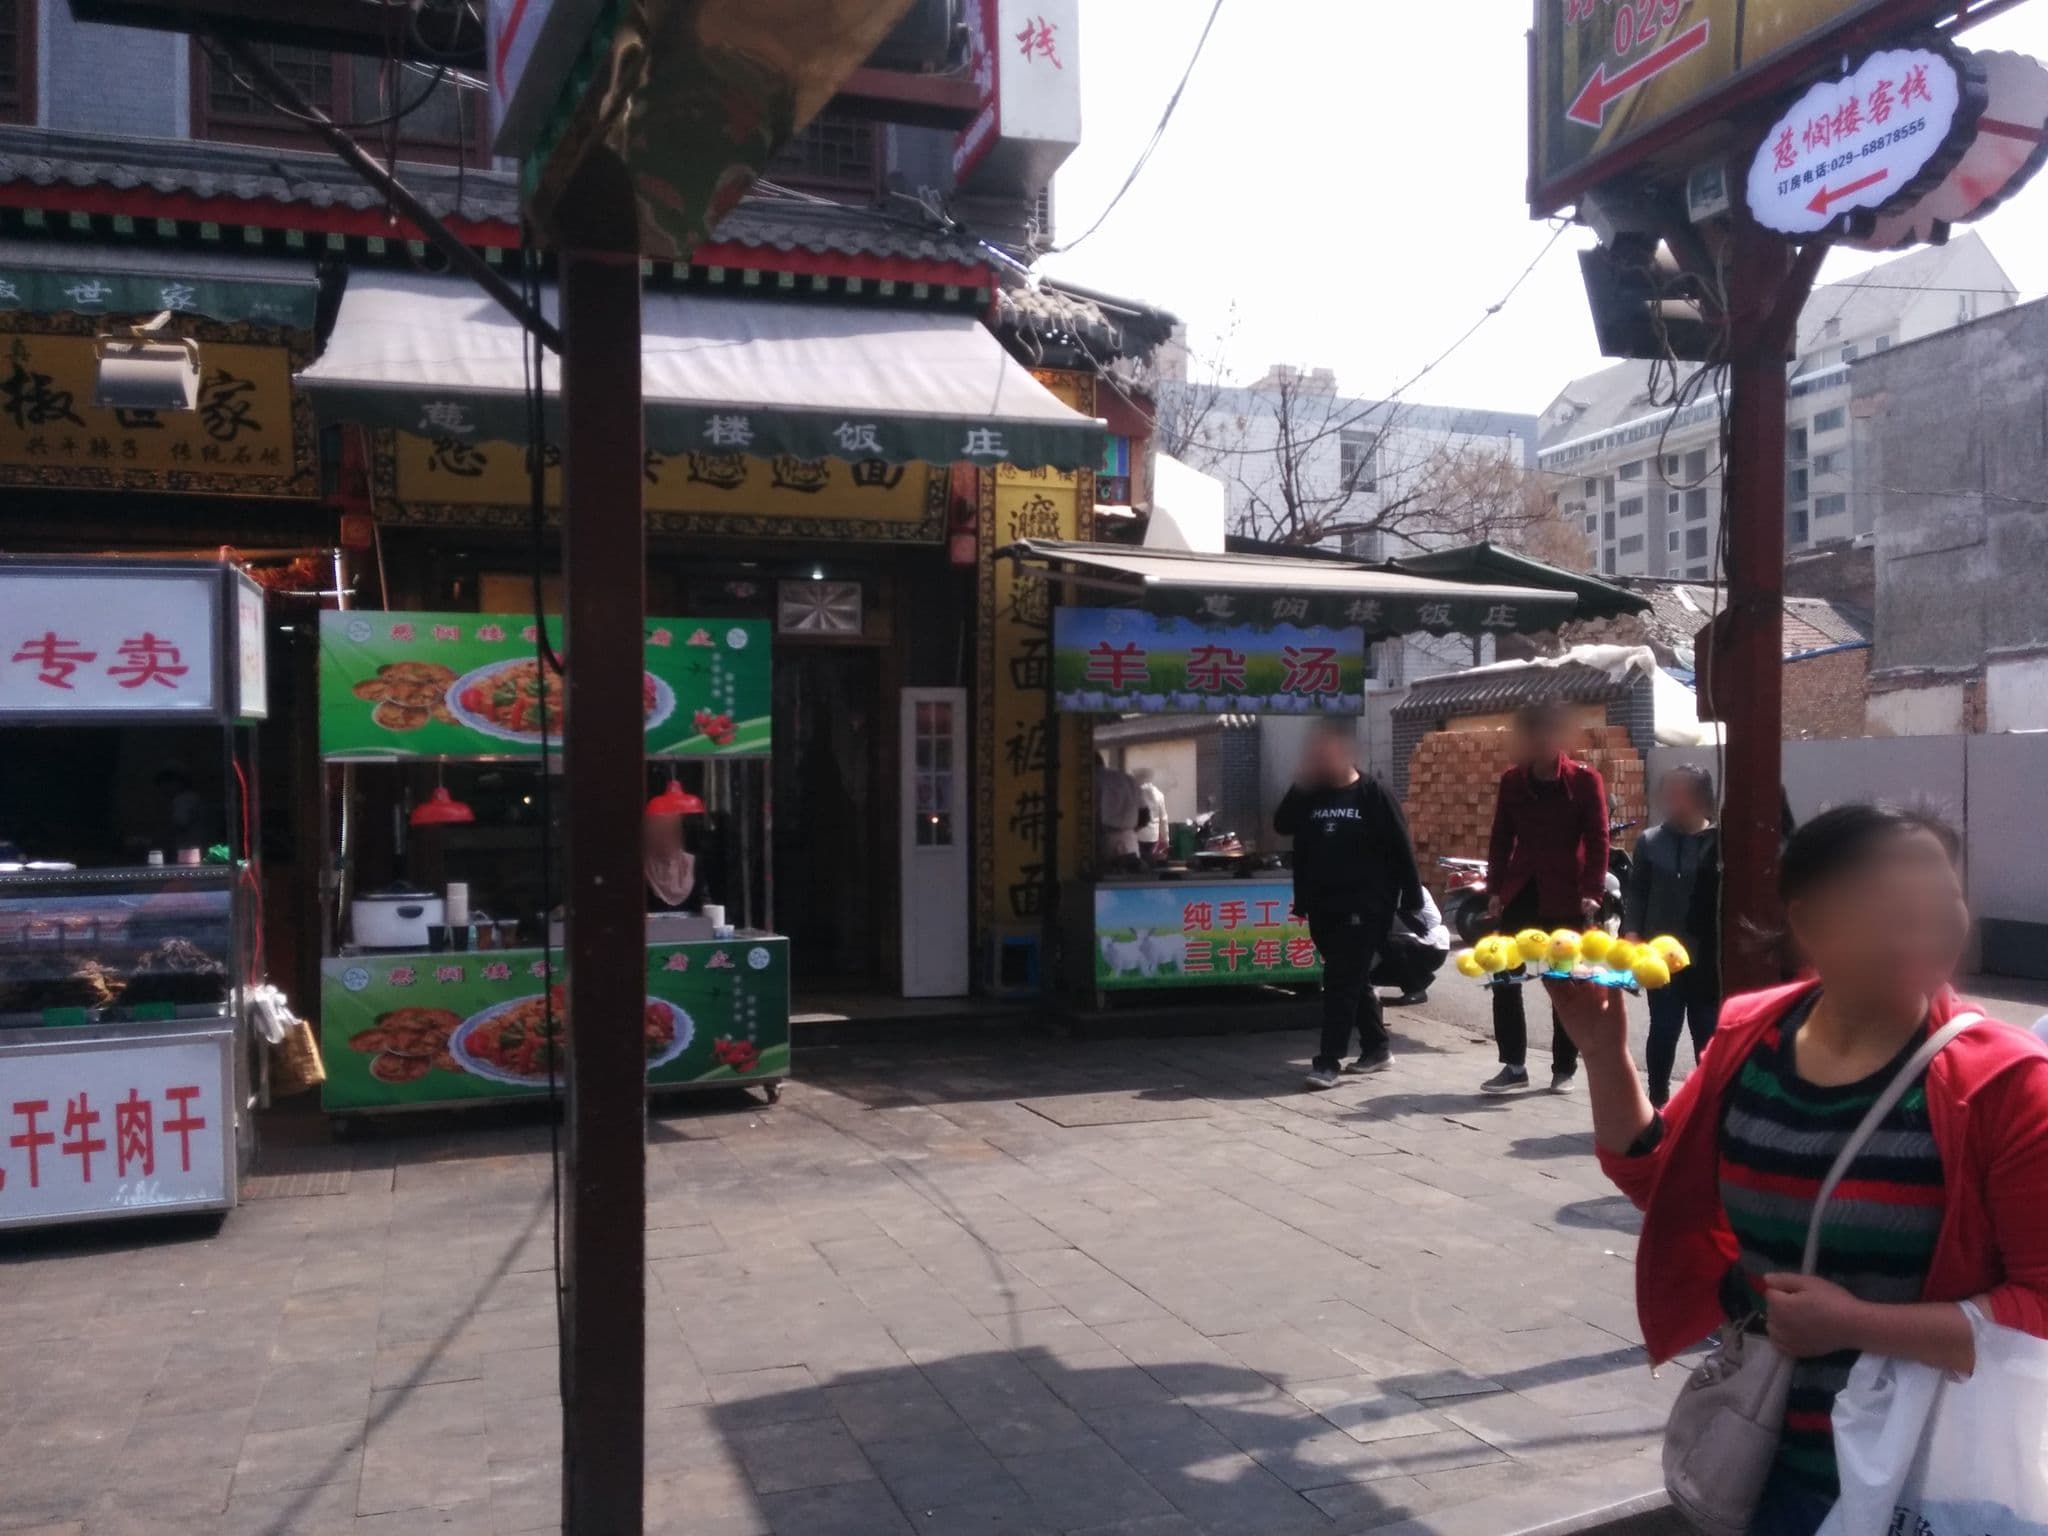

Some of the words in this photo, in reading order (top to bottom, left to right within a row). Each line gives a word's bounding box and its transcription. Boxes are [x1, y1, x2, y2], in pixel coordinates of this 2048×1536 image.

[1015, 15, 1063, 70] 栈
[1771, 63, 1932, 173] 慈悯楼客栈
[1, 352, 262, 442] 椒家
[416, 401, 1009, 458] 慈楼饭庄
[1195, 594, 1518, 629] 慈悯楼饭庄
[11, 631, 189, 690] 专卖
[1086, 641, 1344, 694] 羊杂汤
[1310, 806, 1363, 820] HANNEL
[1183, 938, 1326, 975] 三十年老
[0, 1085, 206, 1193] 干牛肉干
